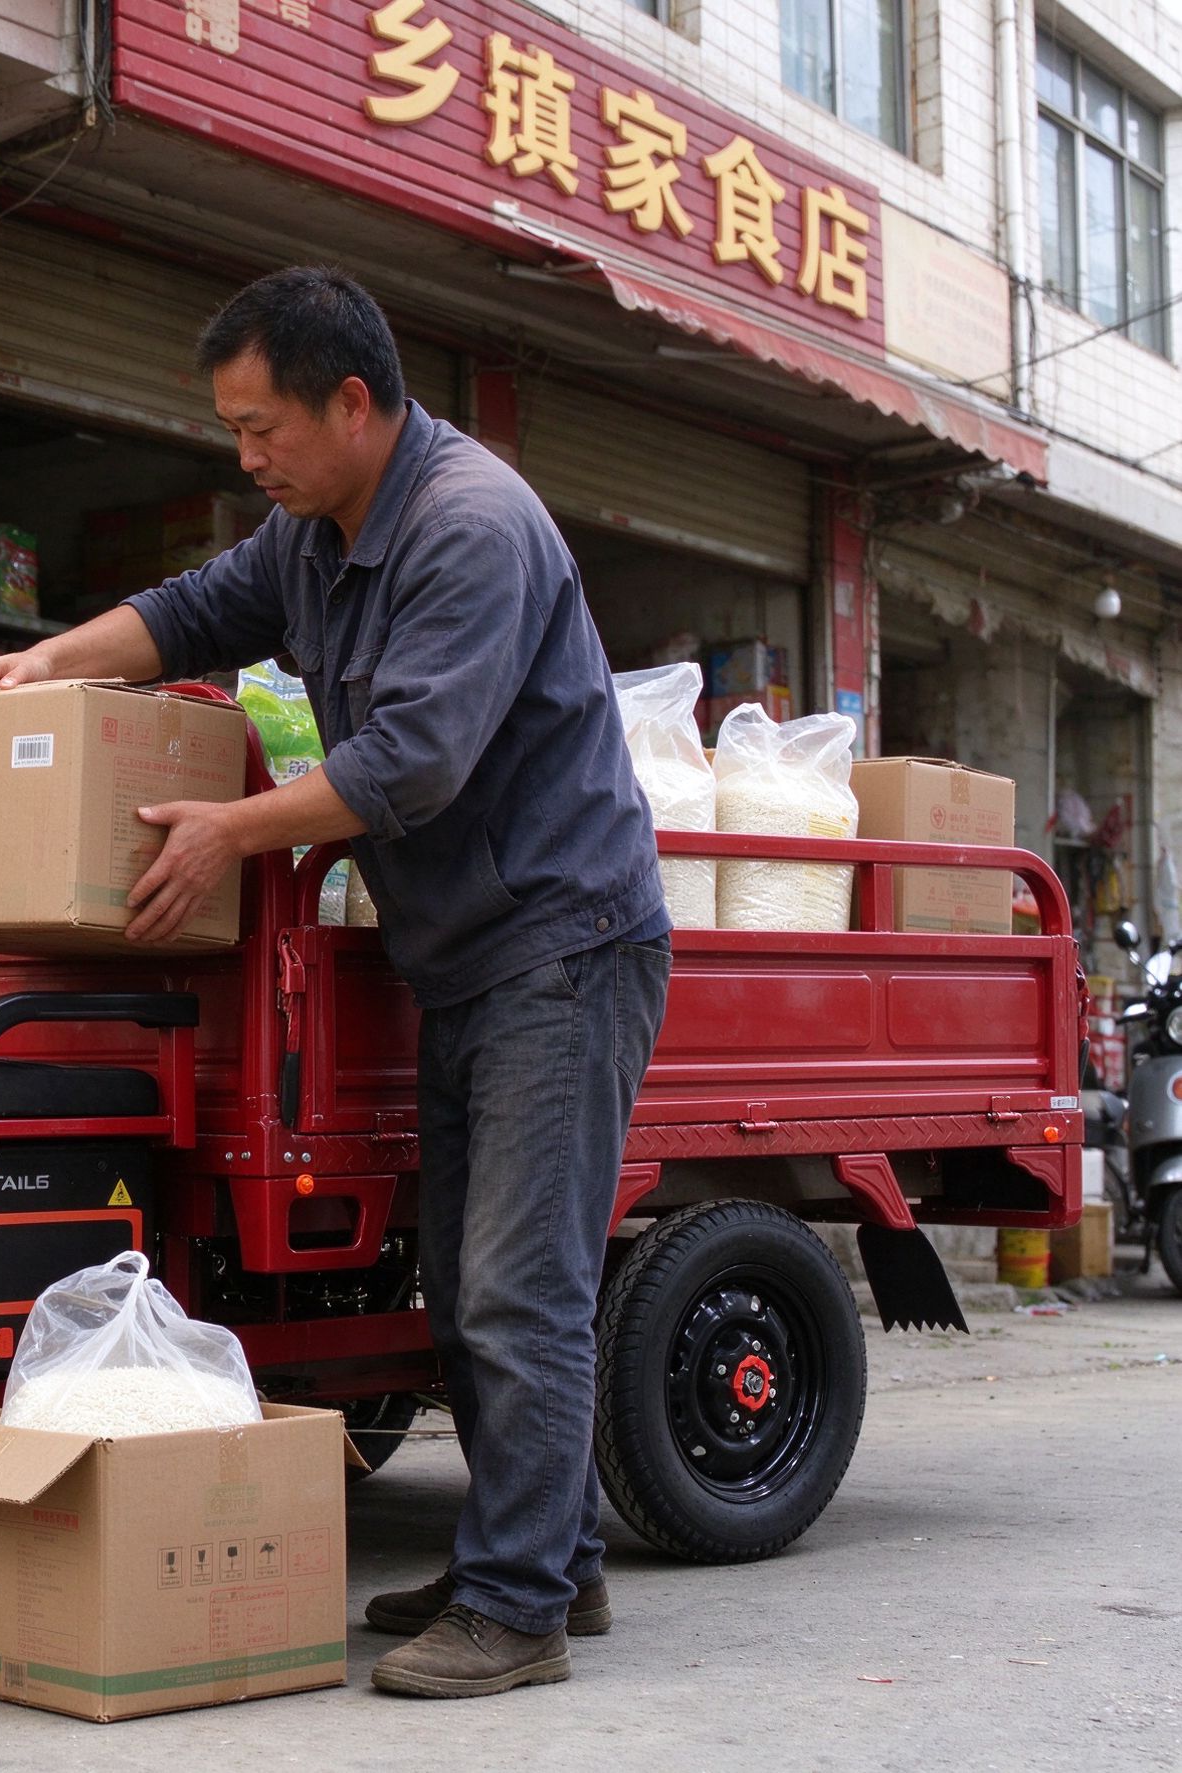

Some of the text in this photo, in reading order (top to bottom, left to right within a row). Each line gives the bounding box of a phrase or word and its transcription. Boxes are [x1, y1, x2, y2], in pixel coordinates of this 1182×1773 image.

[363, 0, 869, 320] 乡镇家食店
